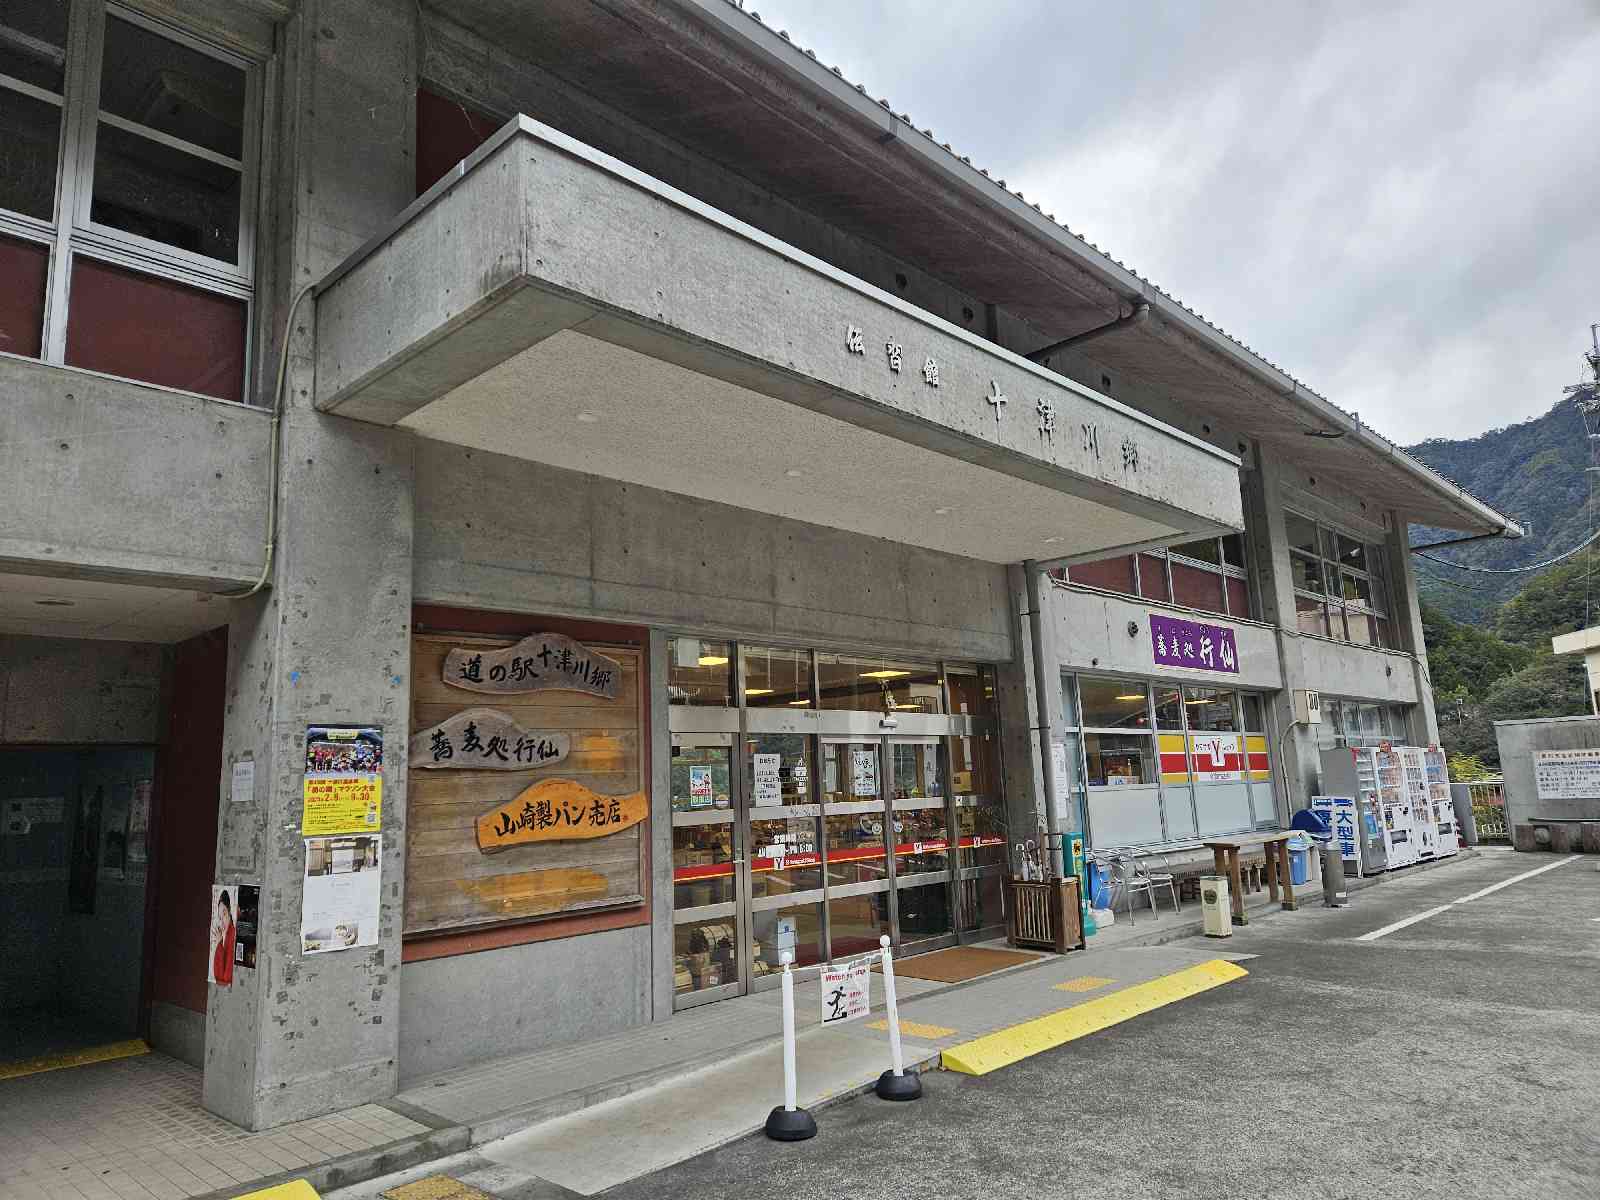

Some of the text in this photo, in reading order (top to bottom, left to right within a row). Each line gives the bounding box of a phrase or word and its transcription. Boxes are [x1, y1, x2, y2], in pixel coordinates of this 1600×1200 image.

[846, 324, 1140, 473] 伝習館 十津川郷
[459, 643, 613, 690] 道の駅十津川郷
[1157, 632, 1235, 670] 蕎麦処行仙
[429, 721, 559, 762] 蕎麦処行仙
[495, 799, 622, 838] 山崎製パン売店
[1335, 809, 1356, 857] 大型車
